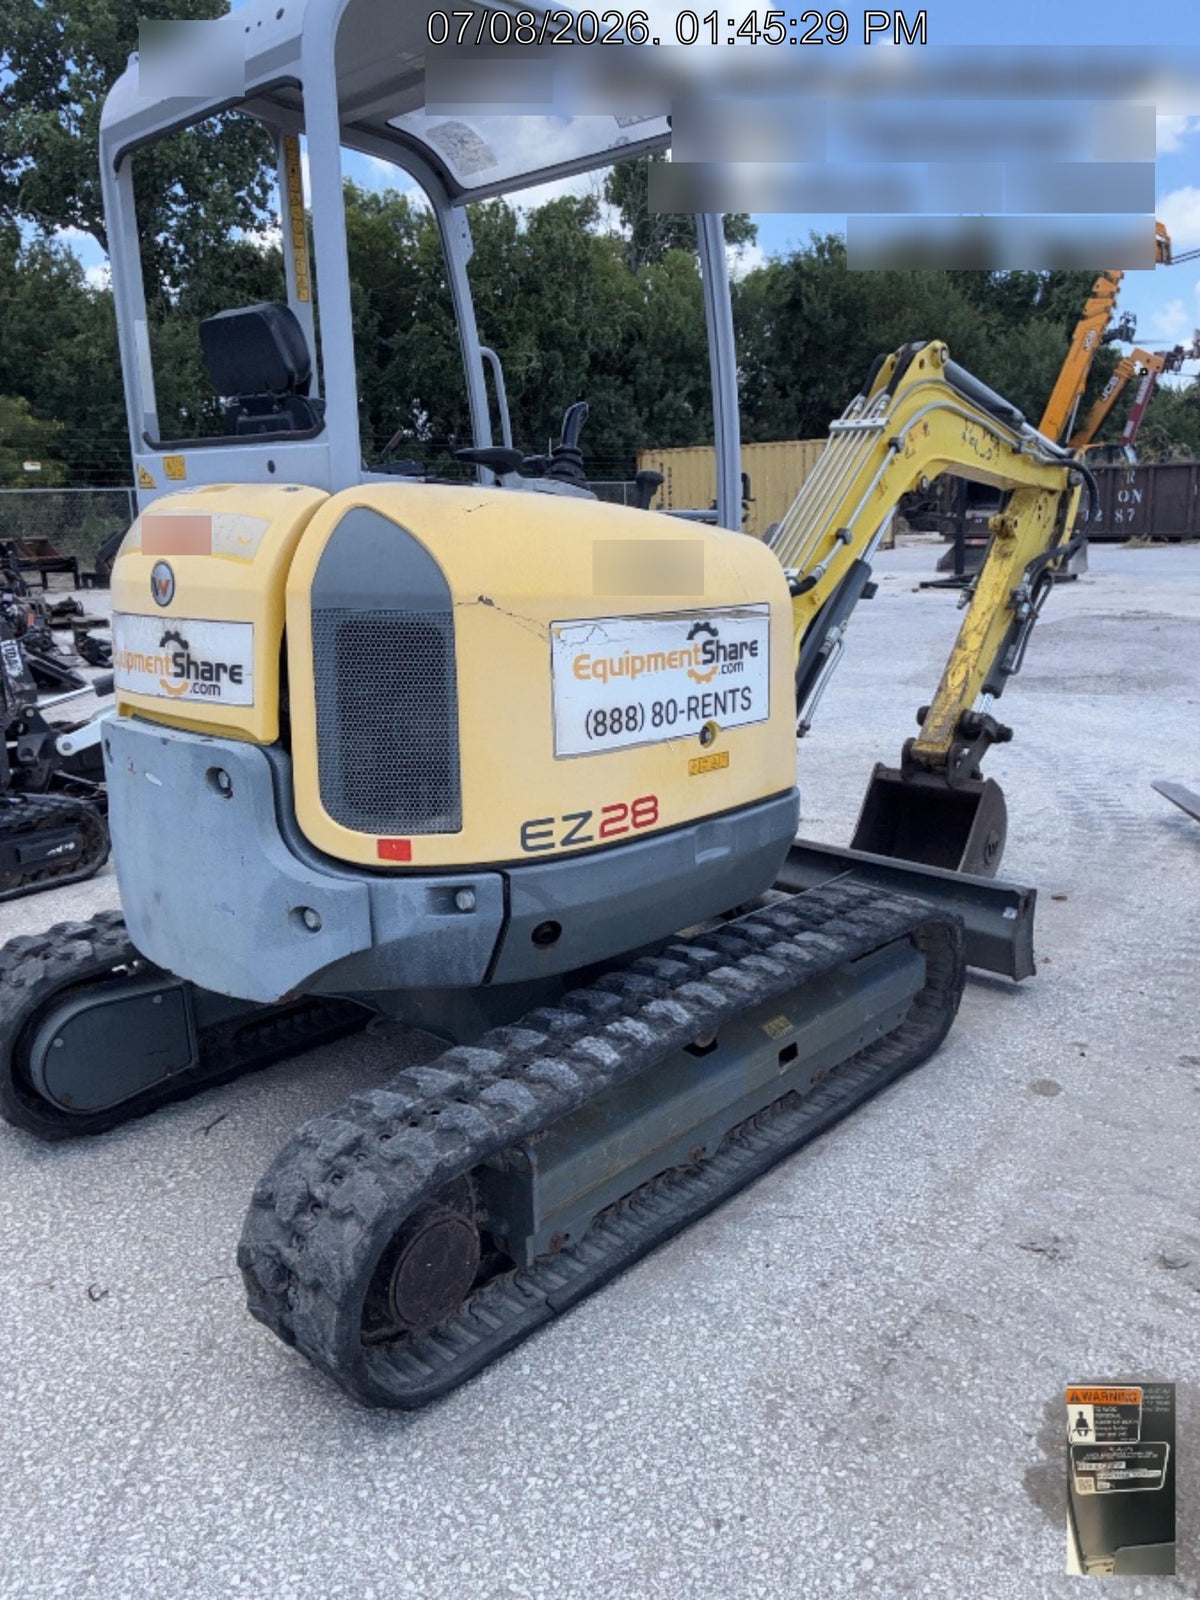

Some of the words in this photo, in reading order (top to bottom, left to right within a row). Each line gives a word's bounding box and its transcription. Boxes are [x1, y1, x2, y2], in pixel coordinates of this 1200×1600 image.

[573, 639, 759, 684] EquipmentShare
[718, 662, 744, 677] .com
[190, 682, 221, 696] .com
[585, 702, 645, 740] (888)
[651, 686, 752, 728] 80-RENTS
[520, 794, 659, 852] EZ28
[1081, 1391, 1137, 1402] WARNING
